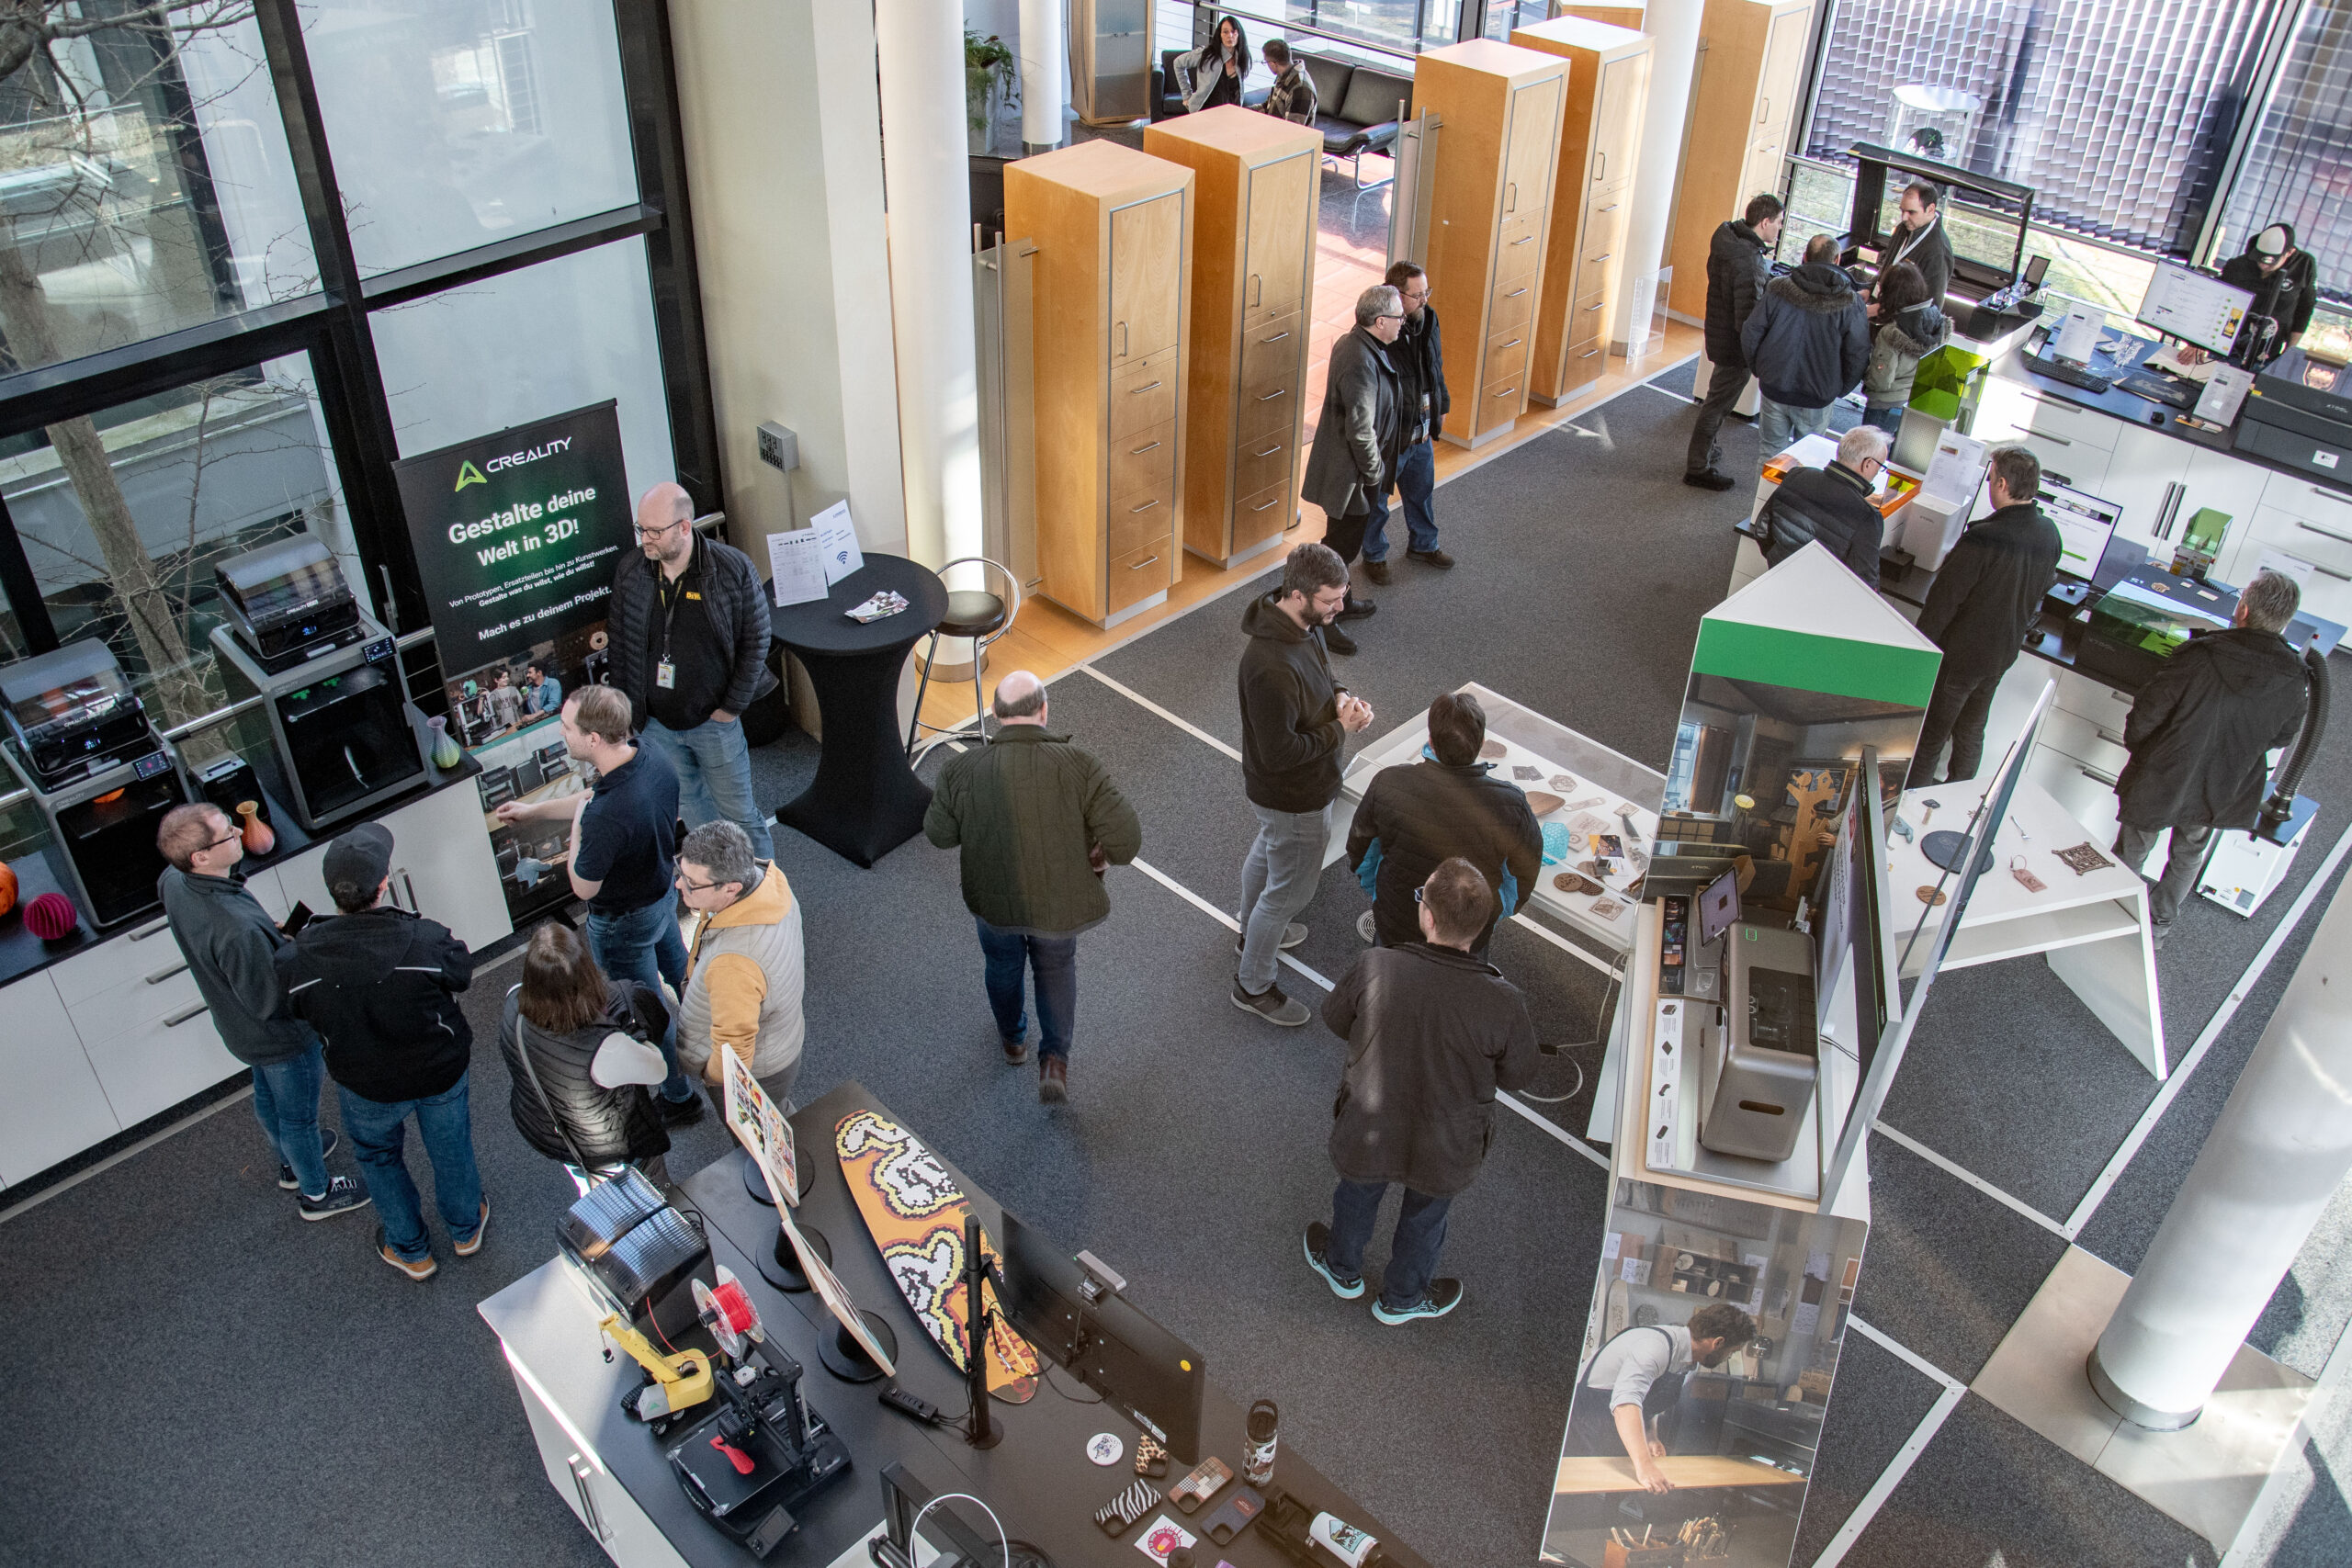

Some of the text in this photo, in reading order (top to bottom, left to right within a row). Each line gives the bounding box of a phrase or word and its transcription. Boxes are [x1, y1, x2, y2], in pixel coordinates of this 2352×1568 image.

[486, 436, 571, 473] CREALITY
[448, 488, 596, 544] Gestalte deine
[477, 519, 580, 567] Welt in 3D!
[448, 545, 619, 608] Von Prototypen, Ersatzteilen bis hin zu Kunstwerken.
[479, 592, 508, 607] Gestalte
[508, 587, 523, 596] was
[523, 582, 533, 591] du
[553, 571, 565, 581] wie
[565, 568, 574, 576] du
[575, 560, 594, 572] willst!
[478, 586, 613, 640] Mach es zu deinem Projekt.
